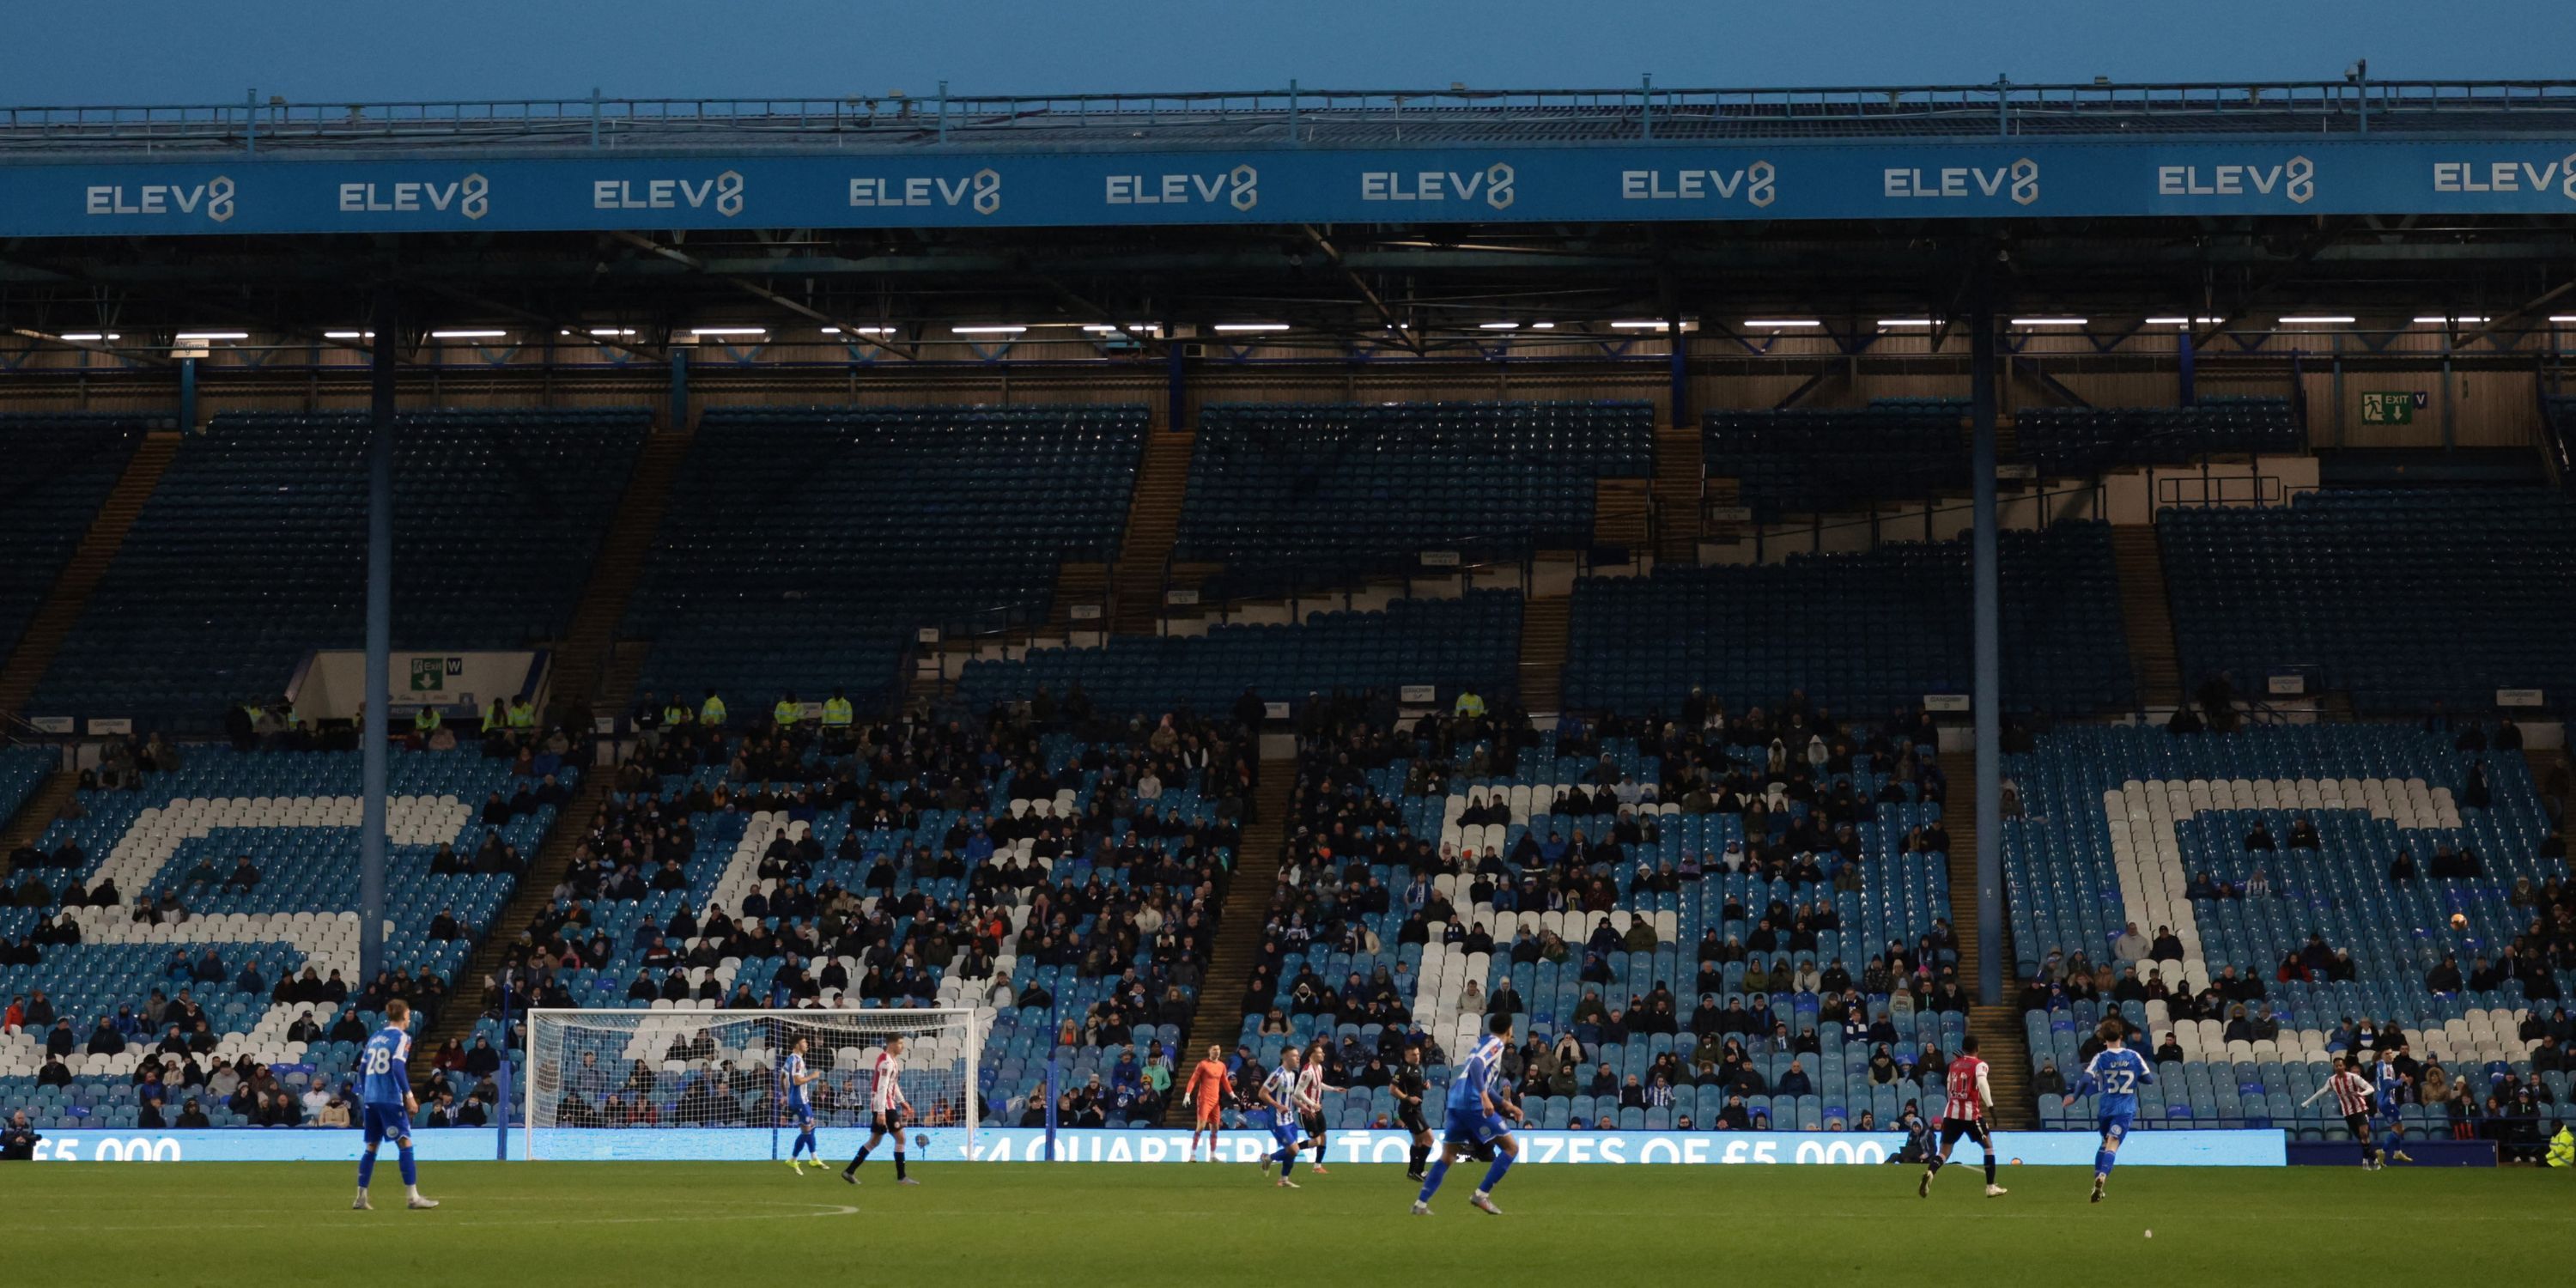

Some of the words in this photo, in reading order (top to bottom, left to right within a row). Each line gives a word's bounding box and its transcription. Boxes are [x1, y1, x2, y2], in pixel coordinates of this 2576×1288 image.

[88, 177, 234, 222] ELEV8
[340, 174, 488, 219] ELEV8
[595, 171, 743, 216] ELEV8
[851, 170, 999, 214] ELEV8
[1107, 166, 1256, 210] ELEV8
[1363, 163, 1513, 209] ELEV8
[1623, 161, 1774, 206] ELEV8
[1885, 159, 2038, 204] ELEV8
[2160, 156, 2313, 204] ELEV8
[2385, 395, 2409, 404] EXIT
[2415, 394, 2426, 404] V
[424, 661, 441, 671] Exit
[447, 660, 461, 672] W
[366, 1047, 391, 1076] 28
[2104, 1069, 2136, 1095] 32
[33, 1137, 181, 1161] £5000
[1640, 1138, 1710, 1163] OF
[1722, 1139, 1885, 1164] £5000
